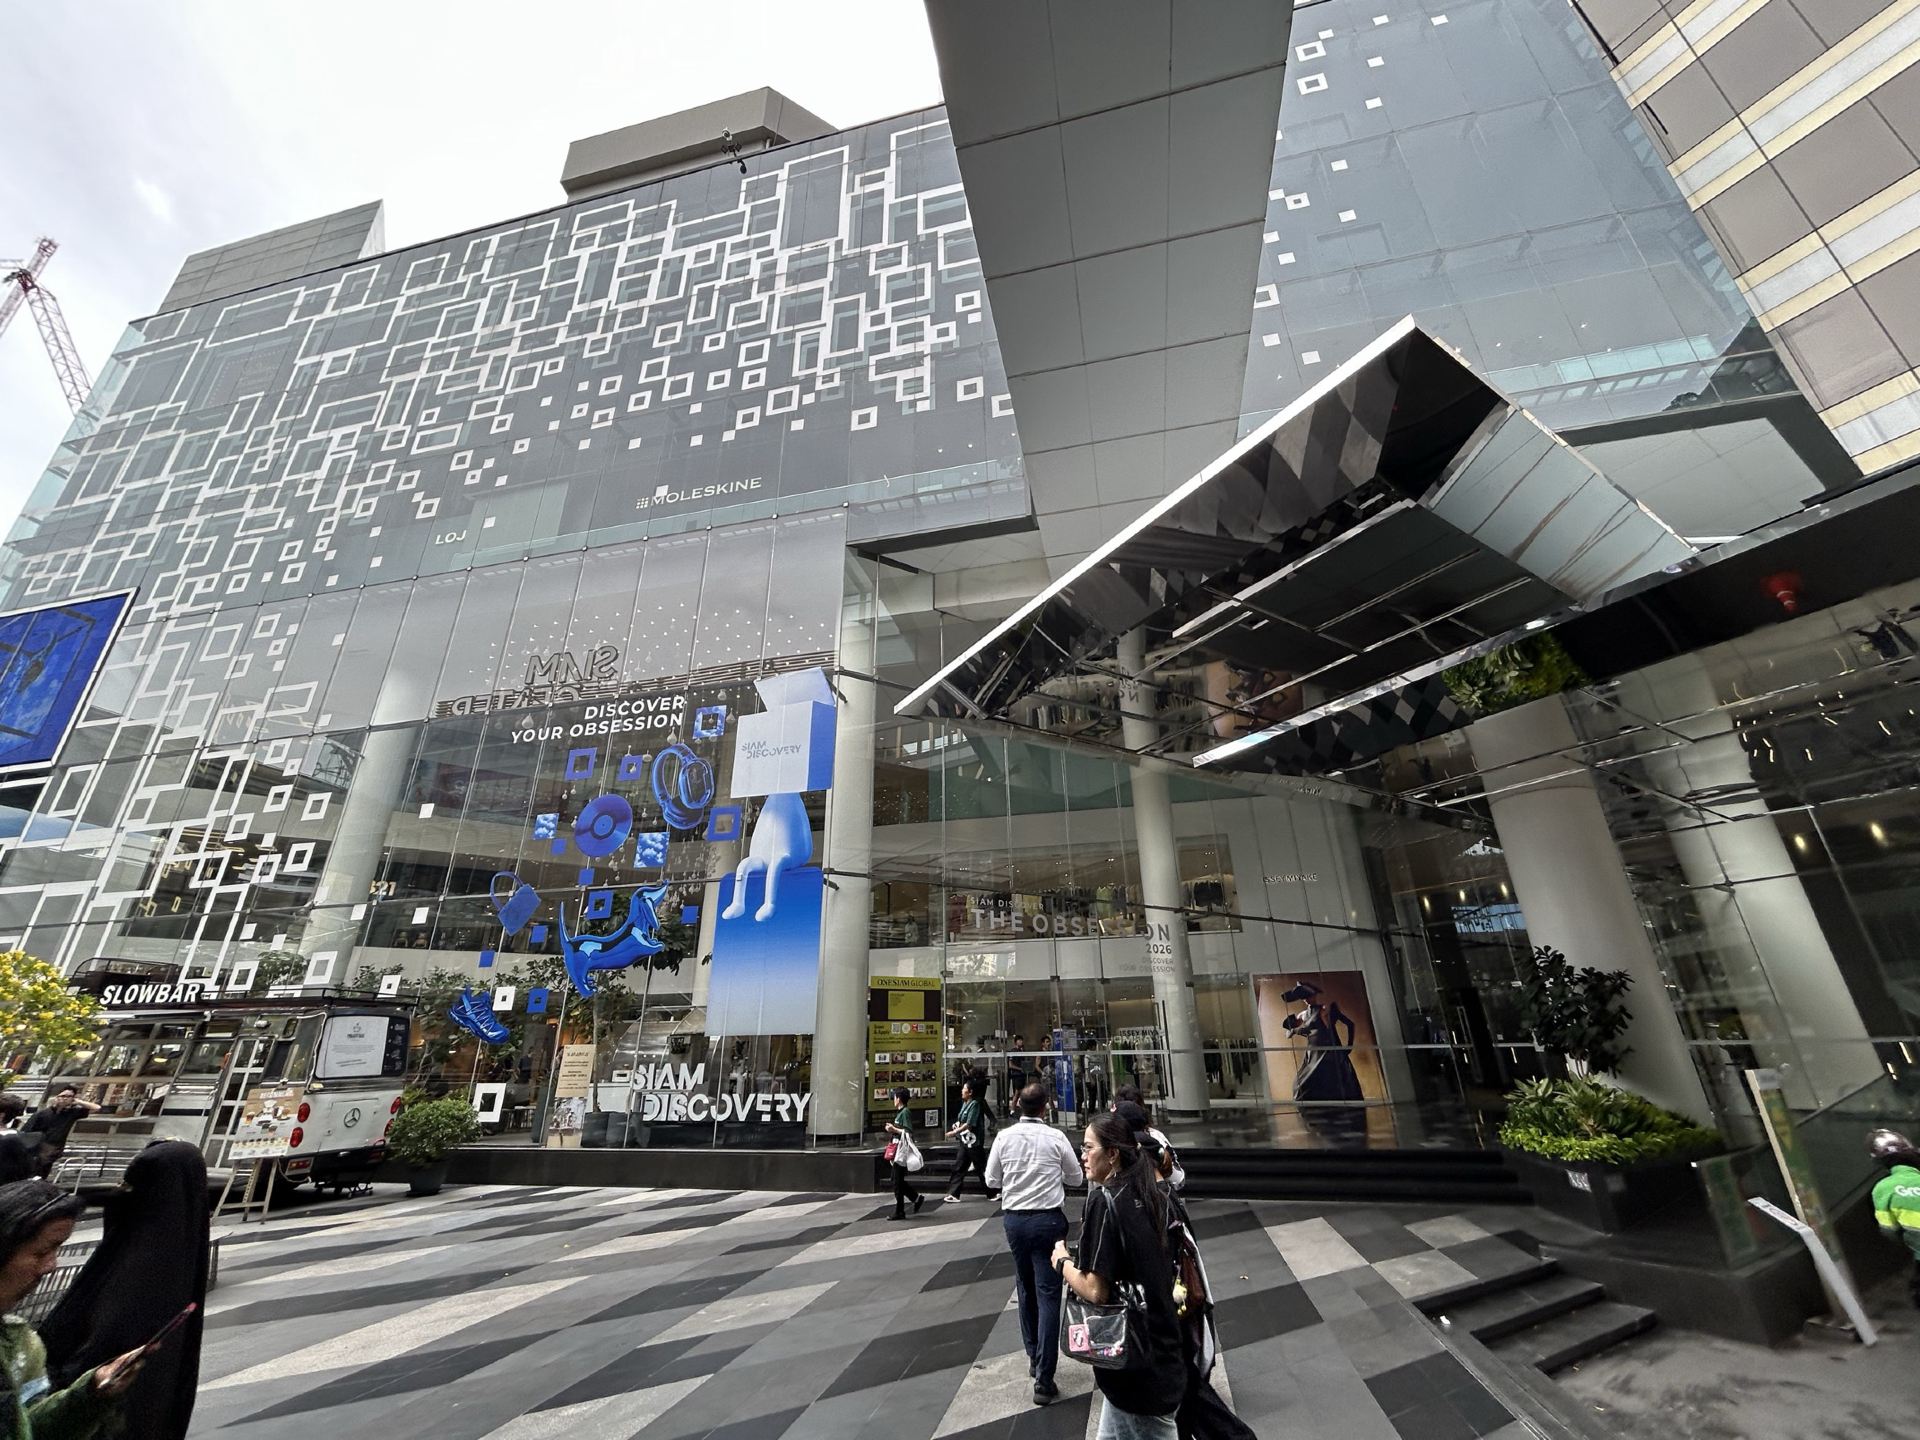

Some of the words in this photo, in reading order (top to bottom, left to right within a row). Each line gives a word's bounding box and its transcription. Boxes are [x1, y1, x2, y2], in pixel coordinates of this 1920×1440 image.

[649, 477, 763, 507] MOLESKINE
[584, 695, 686, 720] DISCOVER
[511, 726, 564, 744] YOUR
[569, 712, 684, 737] OBSESSION
[741, 741, 767, 752] SIAM
[746, 744, 802, 759] DISCOVERY
[970, 896, 994, 906] SIAM
[970, 908, 1024, 932] THE
[1145, 943, 1172, 954] 2026
[99, 983, 201, 1005] SLOWBAR
[633, 1063, 706, 1090] SIAM
[642, 1092, 813, 1122] DISCOVERY
